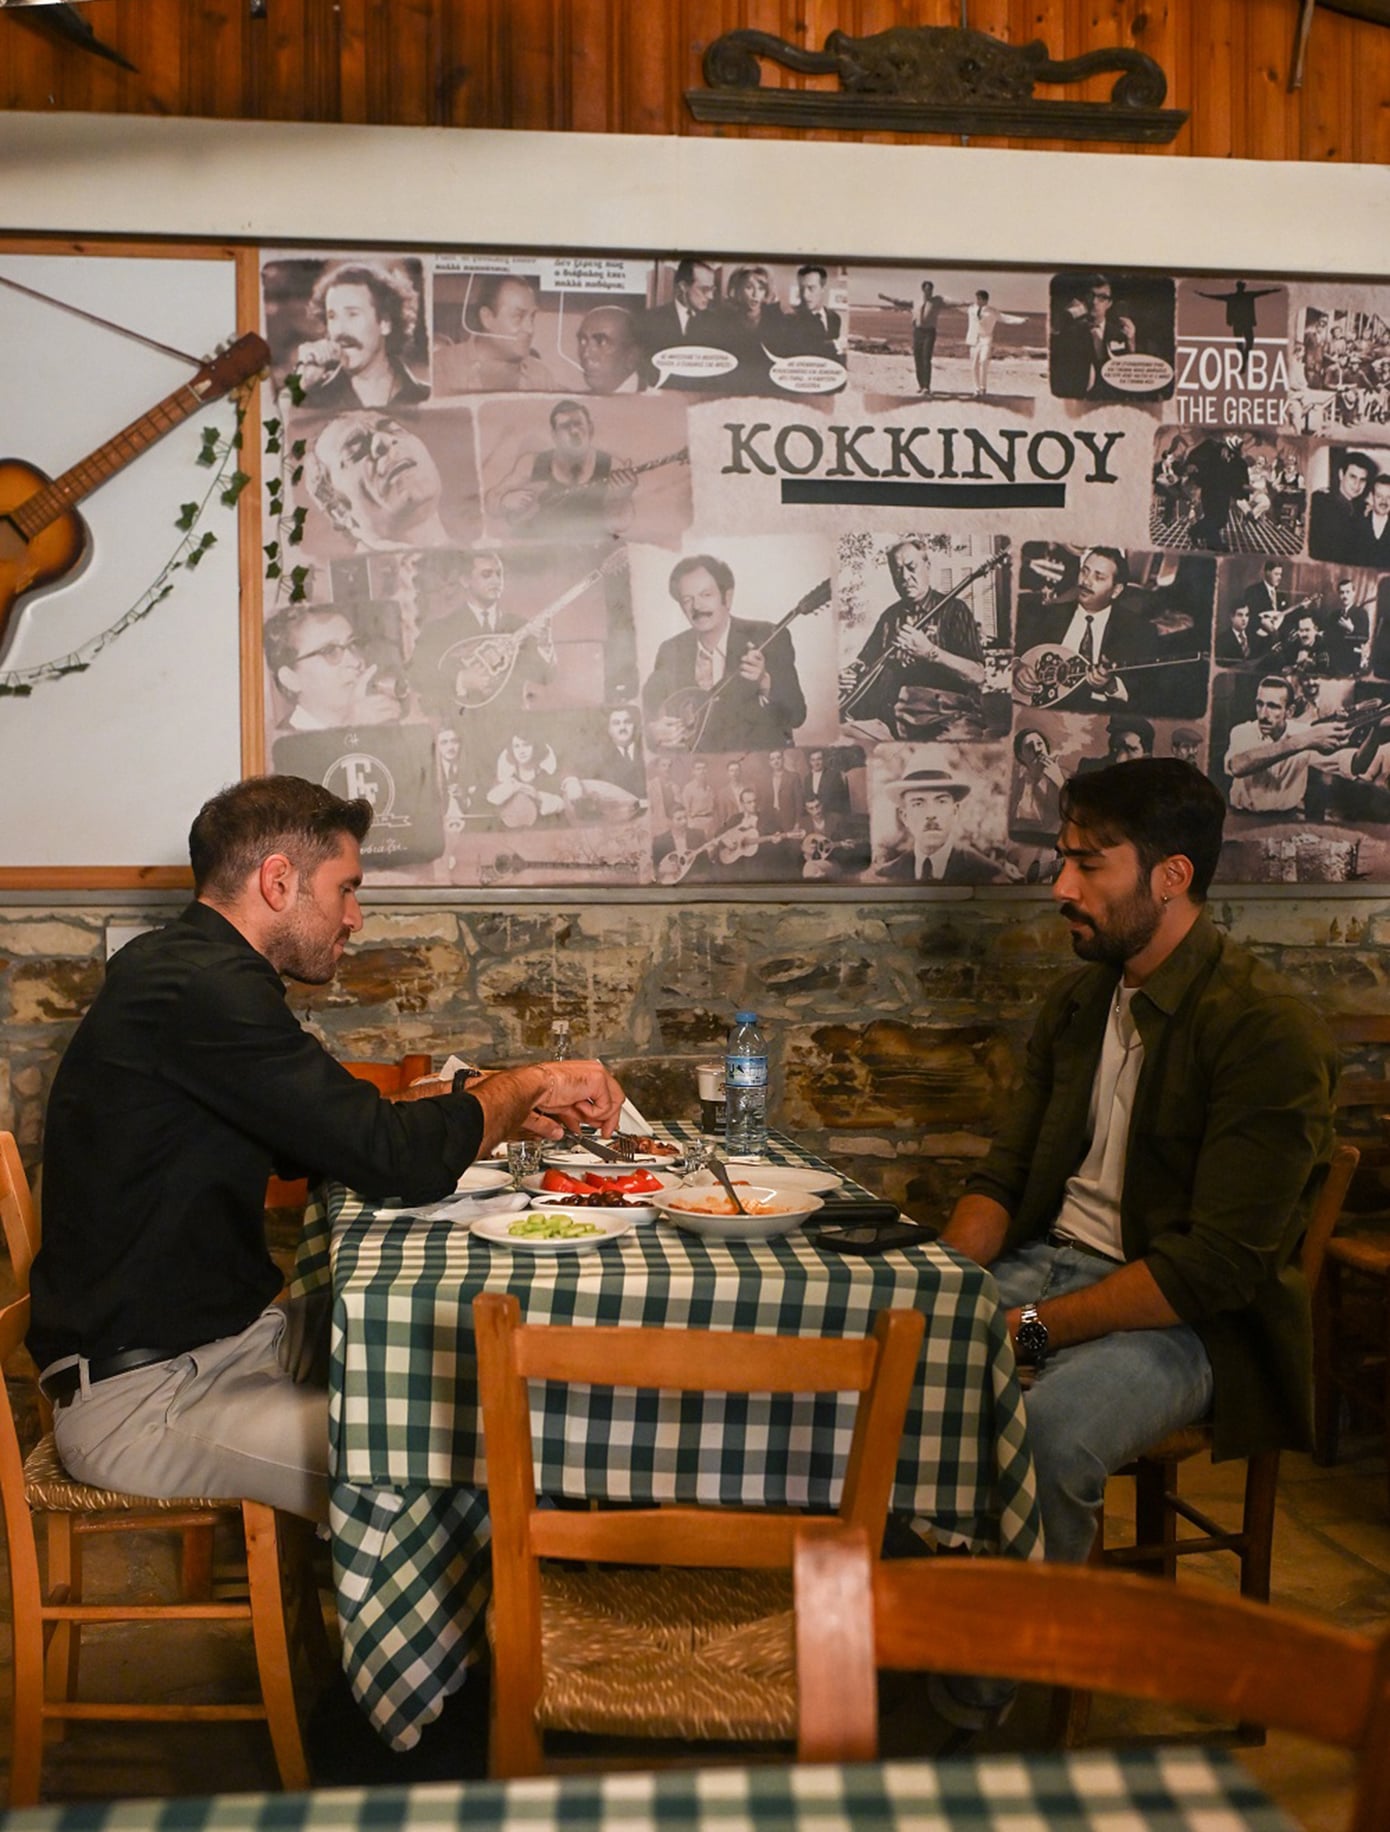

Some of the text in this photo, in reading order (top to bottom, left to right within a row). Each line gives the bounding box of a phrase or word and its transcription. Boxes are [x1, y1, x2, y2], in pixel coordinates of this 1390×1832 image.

[1177, 346, 1290, 392] ZORBA
[1177, 395, 1290, 425] THE GREEK
